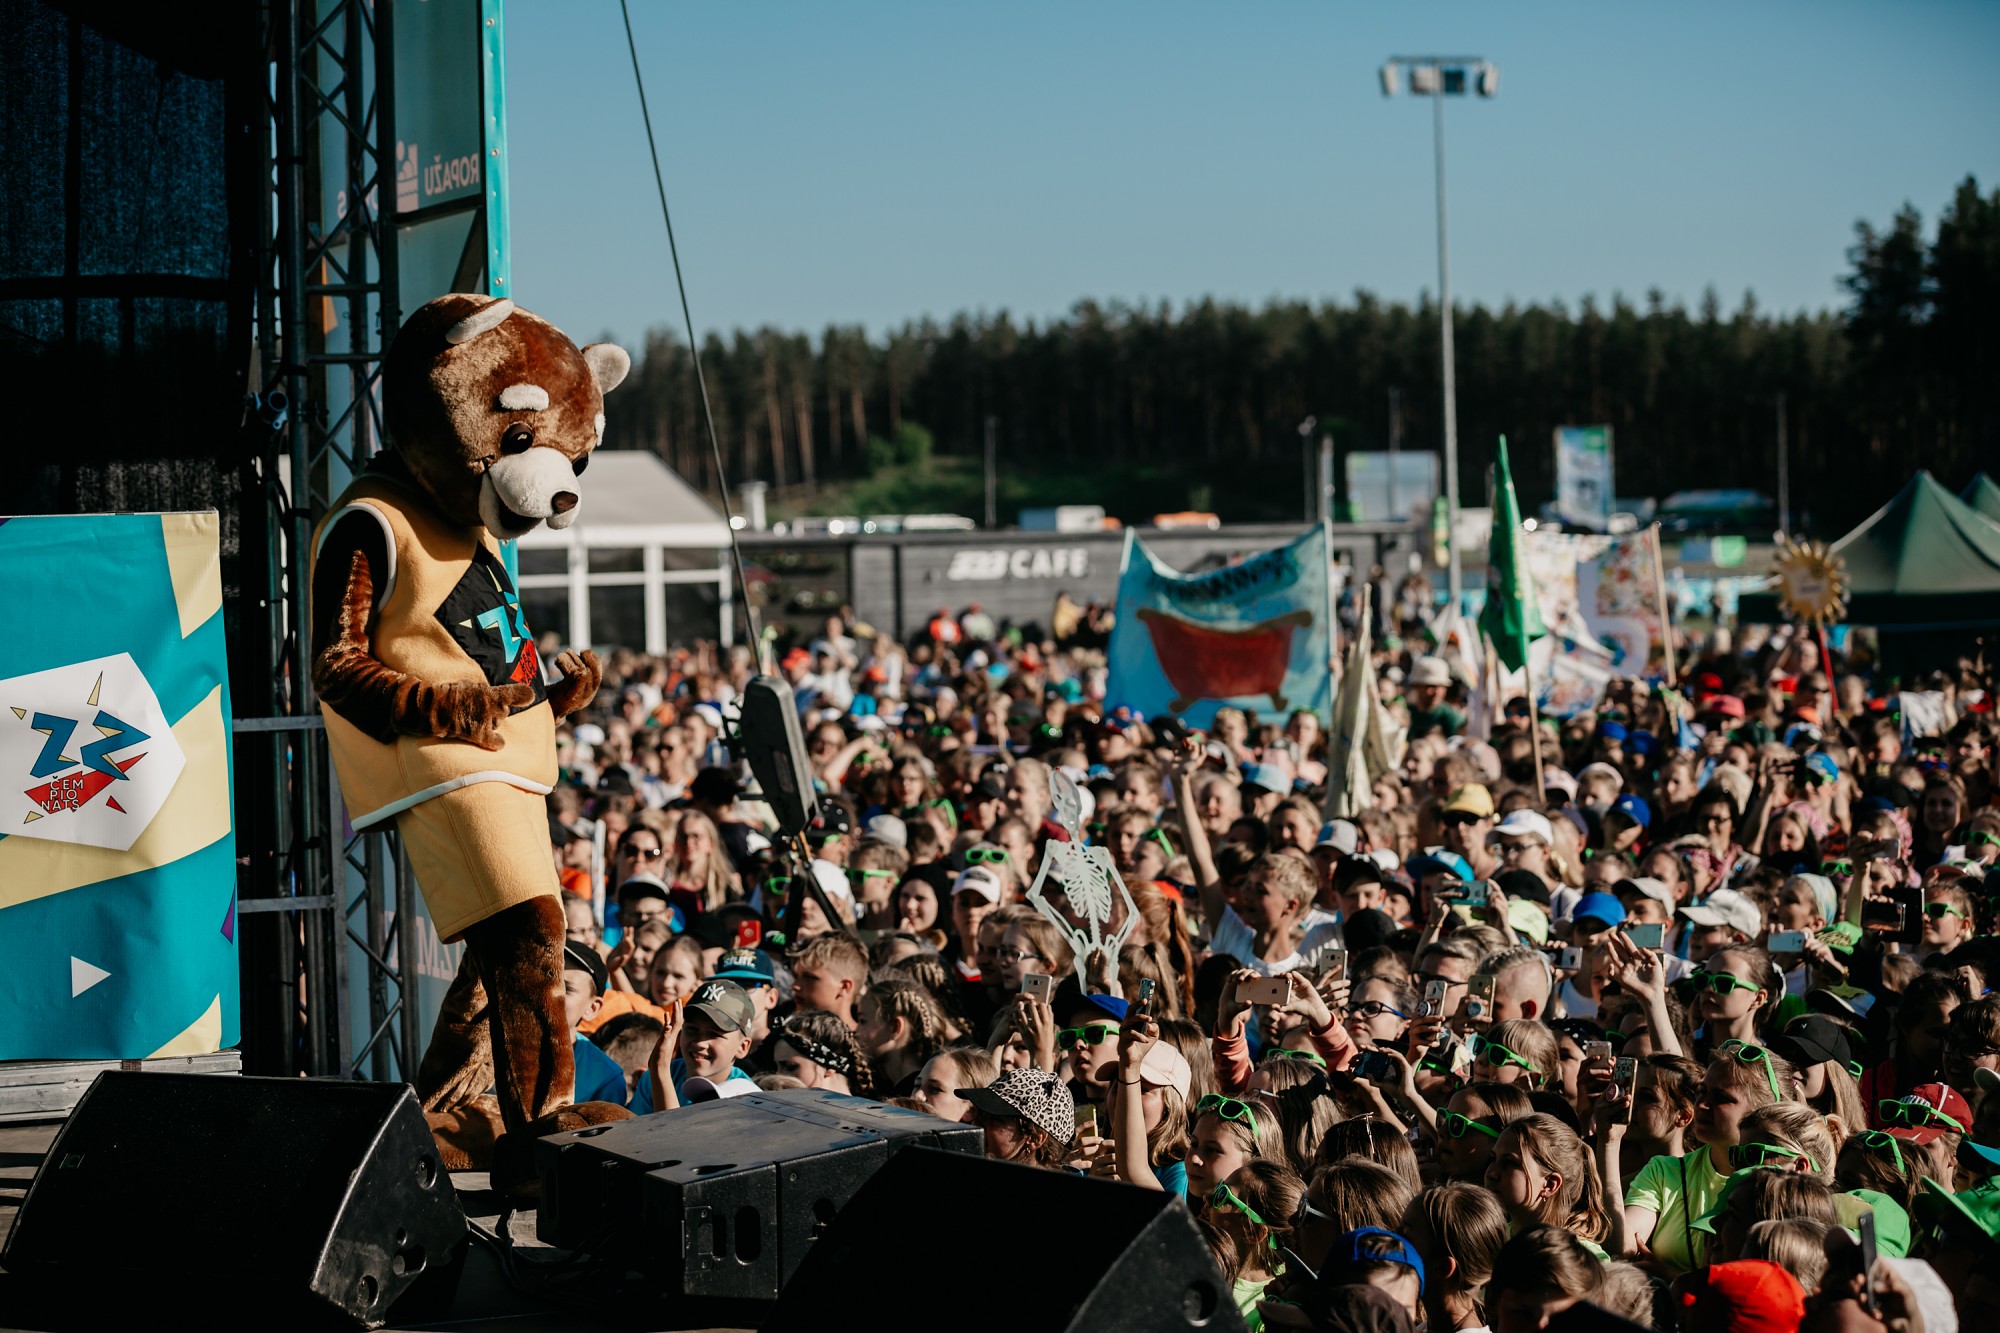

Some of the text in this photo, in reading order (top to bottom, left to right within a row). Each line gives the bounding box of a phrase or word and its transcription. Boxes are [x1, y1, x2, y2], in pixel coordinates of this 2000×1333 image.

[1011, 549, 1088, 579] CAFE
[50, 775, 84, 790] ČEM
[49, 789, 78, 801] PIO
[702, 983, 727, 1002] NY
